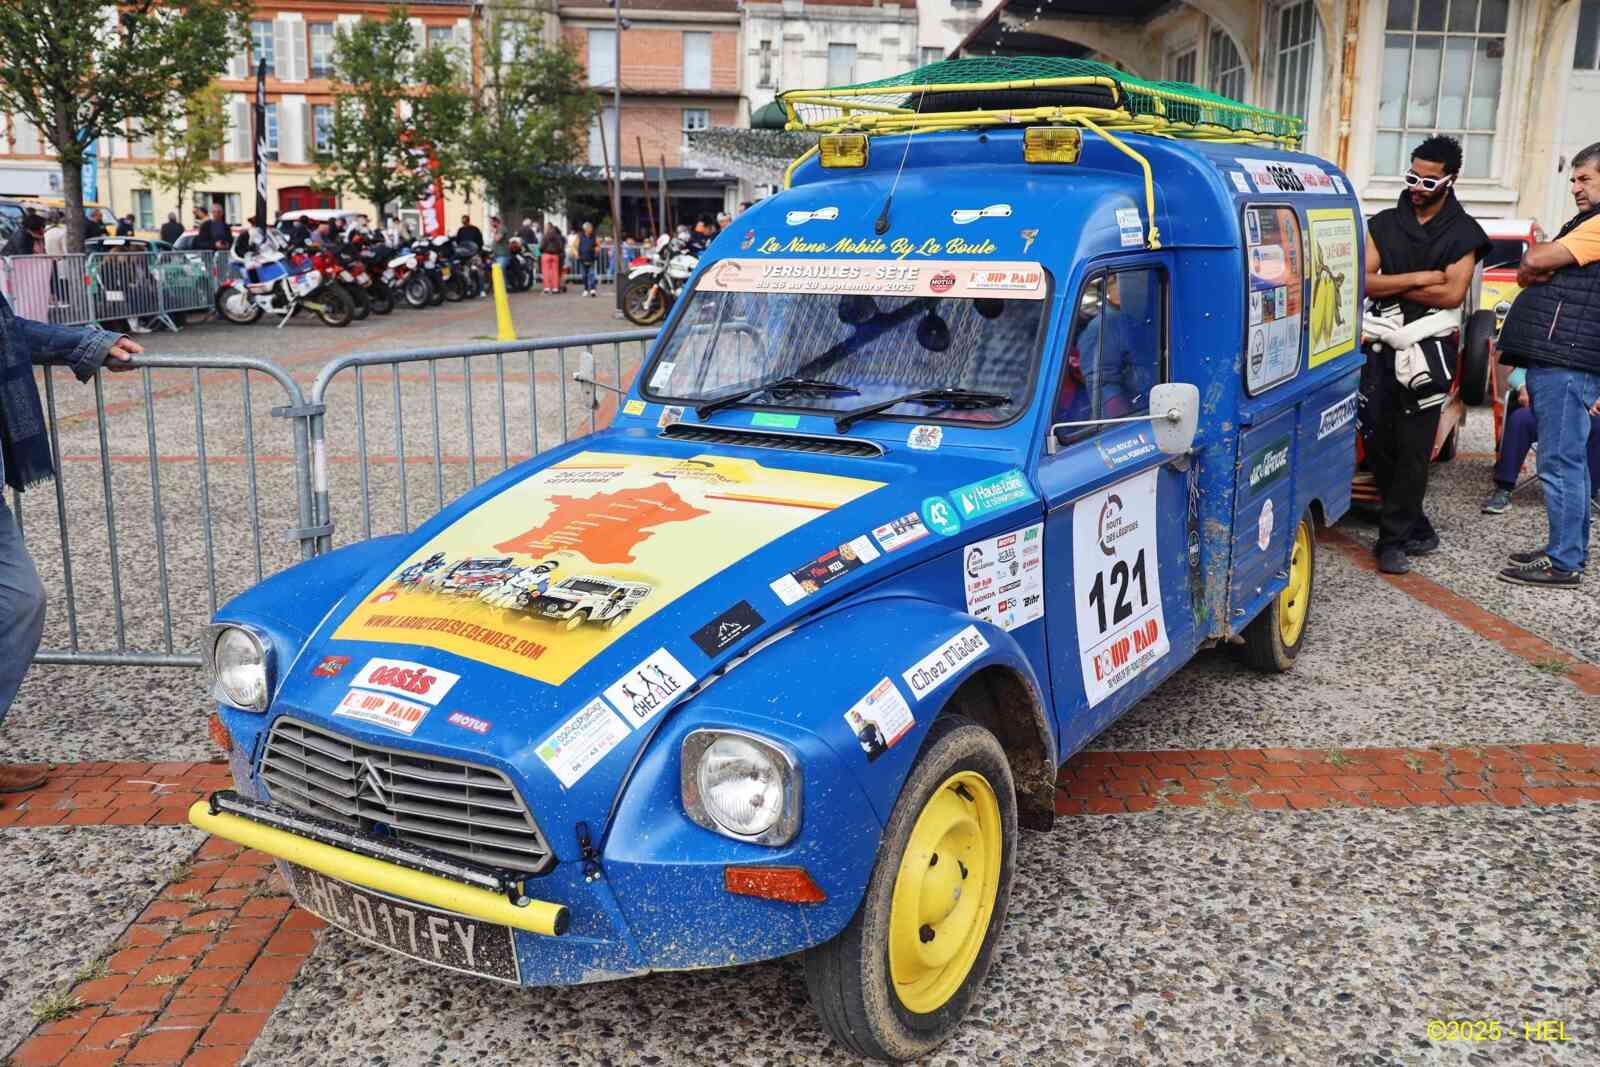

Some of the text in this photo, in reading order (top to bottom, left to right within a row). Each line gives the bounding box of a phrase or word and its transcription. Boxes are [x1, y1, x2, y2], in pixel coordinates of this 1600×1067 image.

[757, 237, 998, 261] La Nano Mobile By La Boule
[761, 264, 861, 279] VERSAILLES
[886, 282, 915, 292] 2025
[930, 502, 948, 526] 43
[1089, 547, 1149, 635] 121
[368, 665, 438, 695] oasis
[911, 659, 948, 691] Chez
[384, 700, 424, 723] RAID
[632, 693, 661, 719] CHEZ
[450, 712, 490, 732] MOTUL
